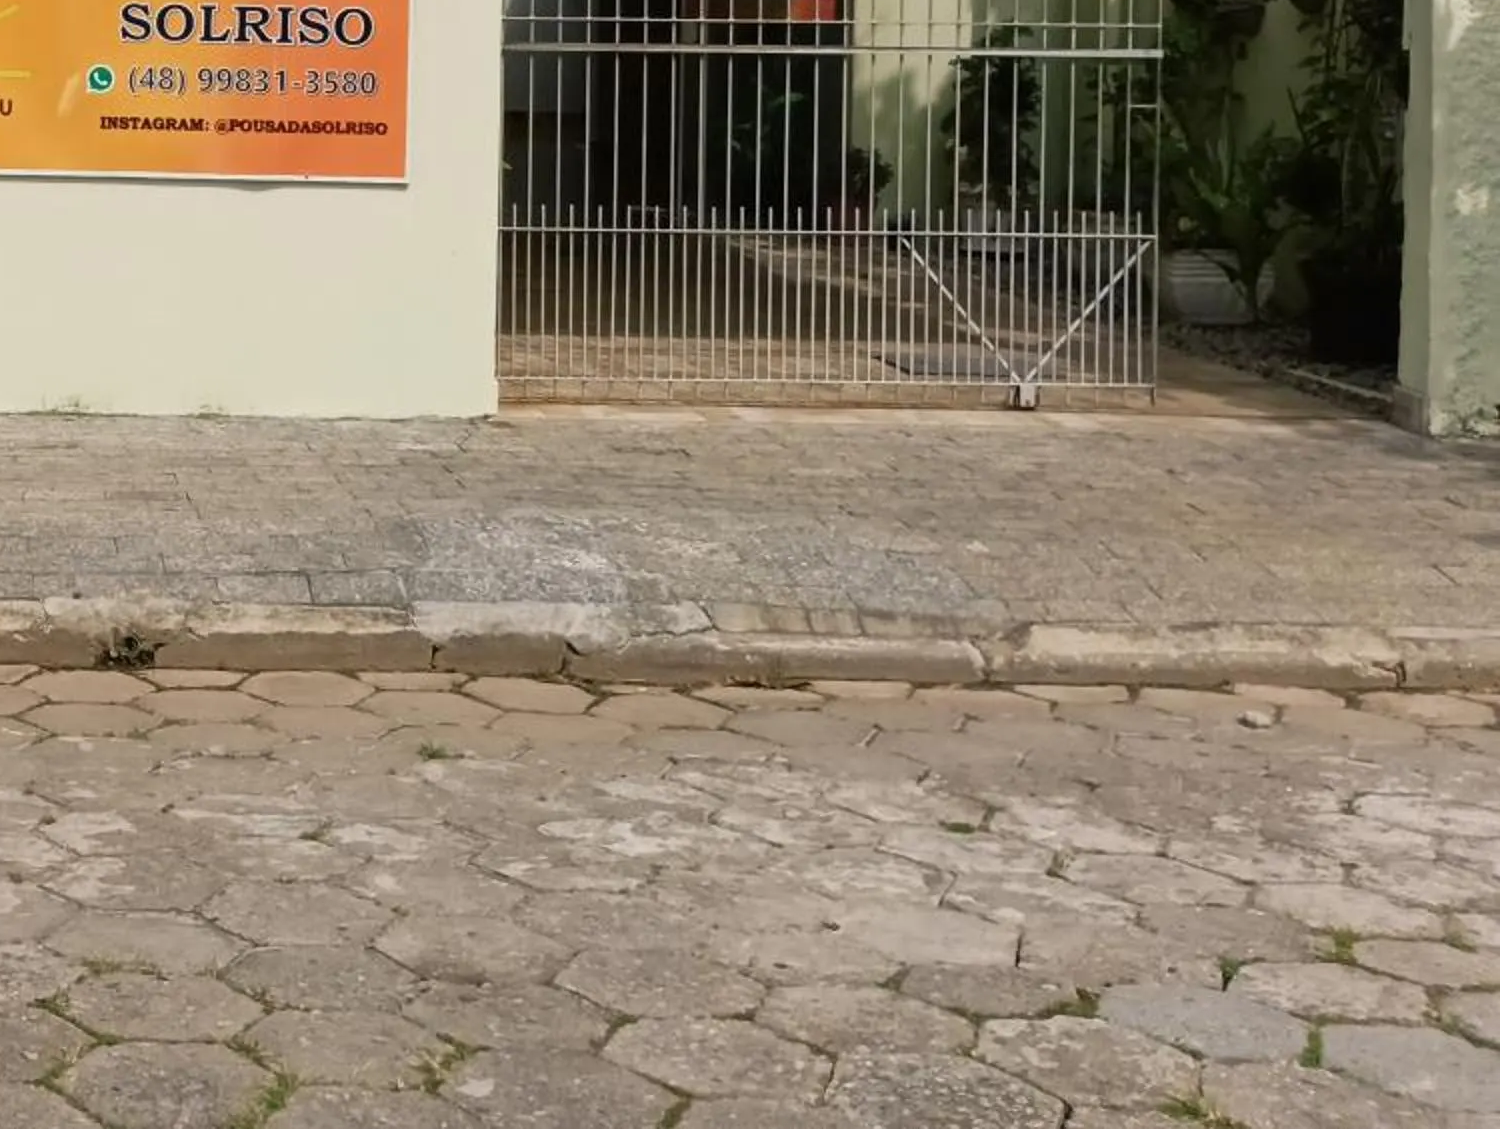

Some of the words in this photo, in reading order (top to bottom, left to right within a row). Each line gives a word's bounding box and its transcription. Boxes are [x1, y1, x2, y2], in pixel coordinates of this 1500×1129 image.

[120, 3, 375, 47] SOLRISO
[128, 66, 187, 95] (48)
[197, 67, 378, 96] 99831-3580
[100, 116, 210, 132] INSTAGRAM:
[214, 118, 388, 135] @POUSADASOLRISO
